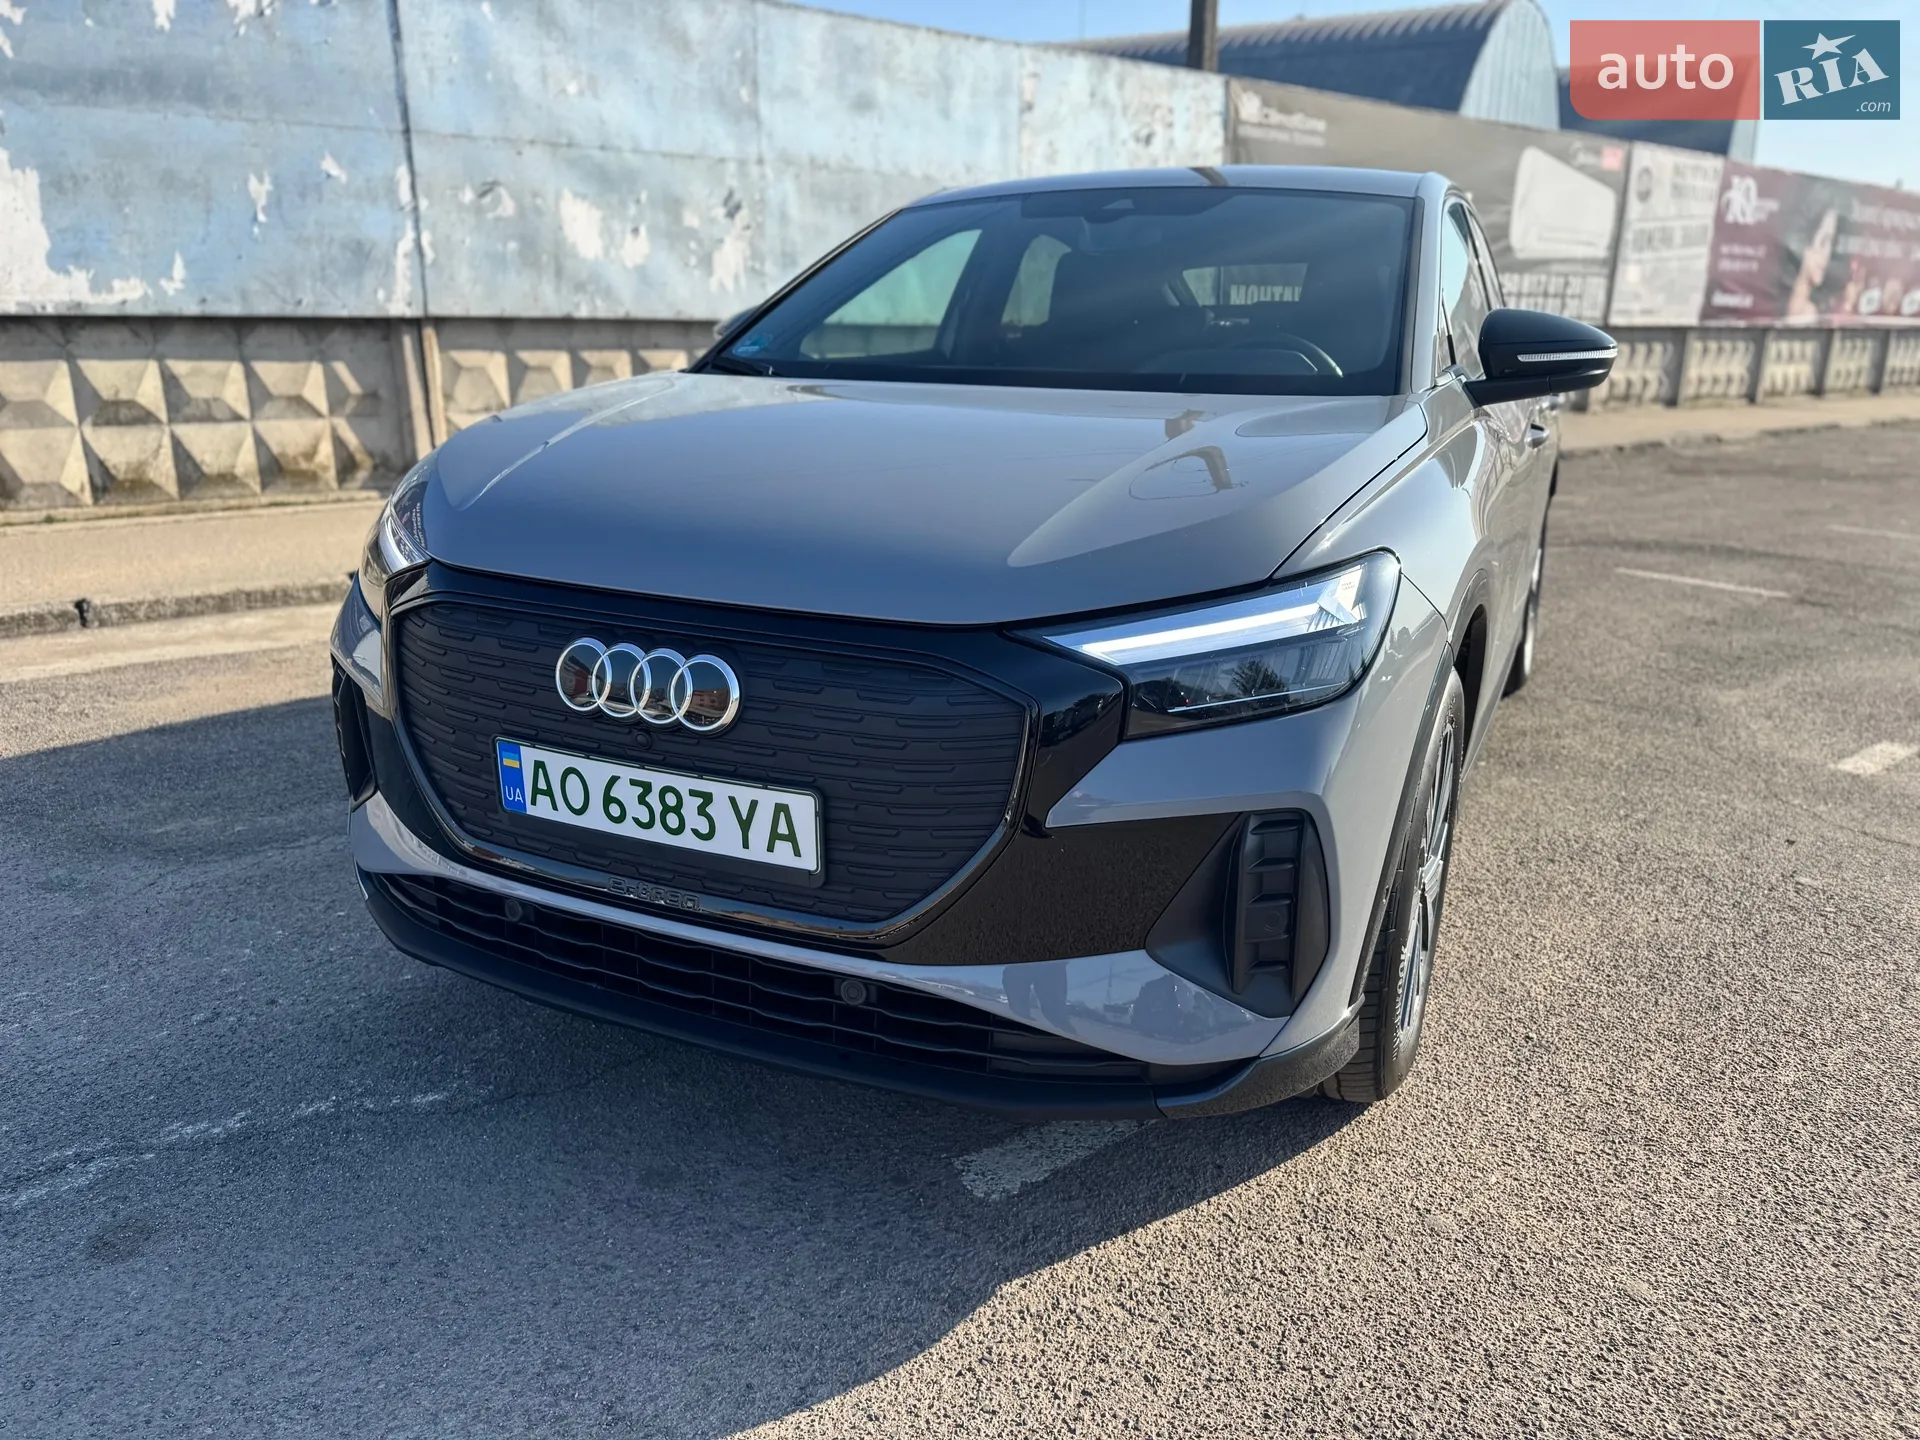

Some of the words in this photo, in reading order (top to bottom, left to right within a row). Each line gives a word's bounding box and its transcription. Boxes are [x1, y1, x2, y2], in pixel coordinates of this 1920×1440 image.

[505, 785, 524, 804] UA
[529, 760, 591, 816] AO
[602, 774, 717, 842] 6383
[728, 795, 802, 858] YA
